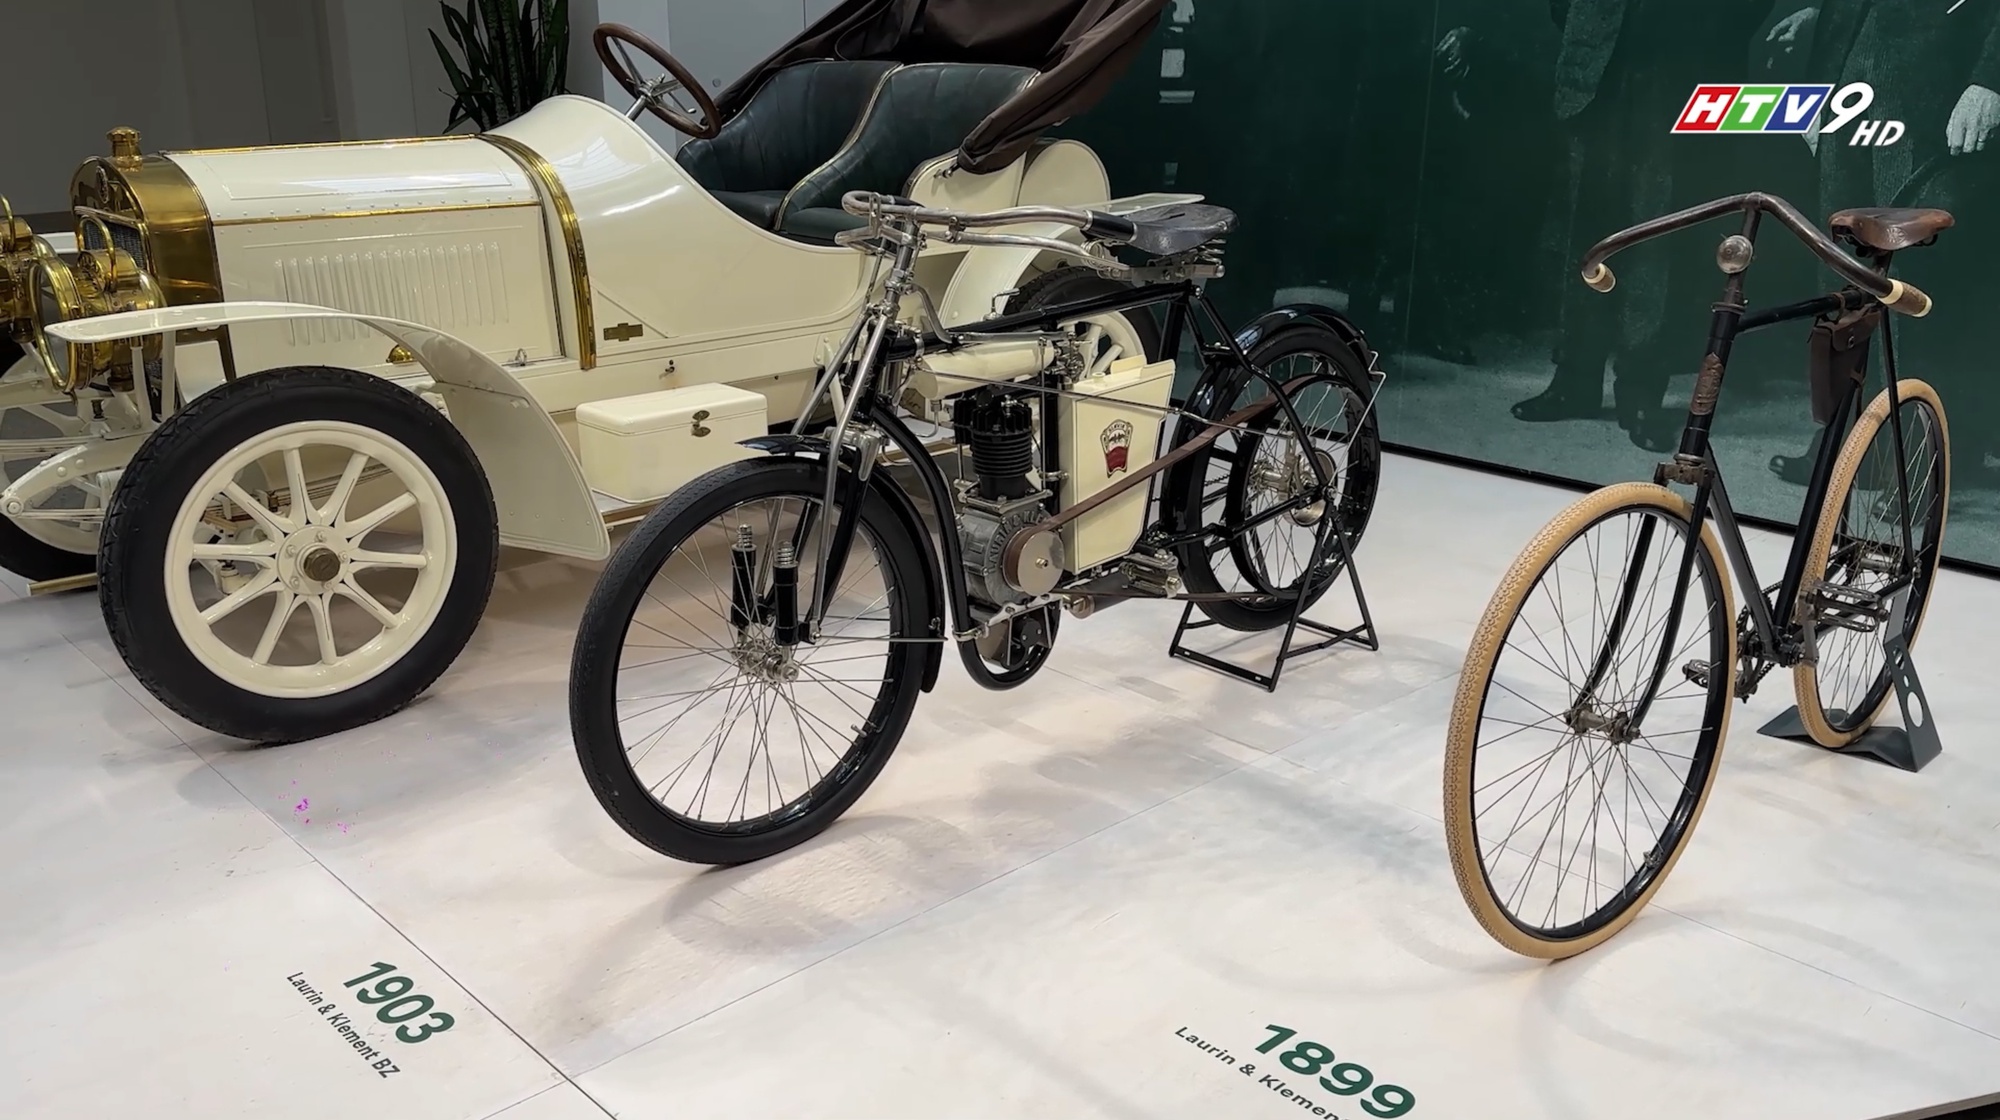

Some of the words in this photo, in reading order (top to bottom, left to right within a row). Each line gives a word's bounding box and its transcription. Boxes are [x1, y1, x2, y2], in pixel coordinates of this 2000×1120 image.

[287, 971, 325, 1006] Laurin
[317, 1003, 336, 1016] &
[327, 1012, 380, 1061] Klement
[371, 1057, 401, 1079] BZ
[343, 961, 455, 1044] 1903
[1174, 1026, 1236, 1065] Laurin
[1239, 1063, 1257, 1077] &
[1258, 1074, 1350, 1120] Klemen
[1254, 1023, 1416, 1119] 1899
